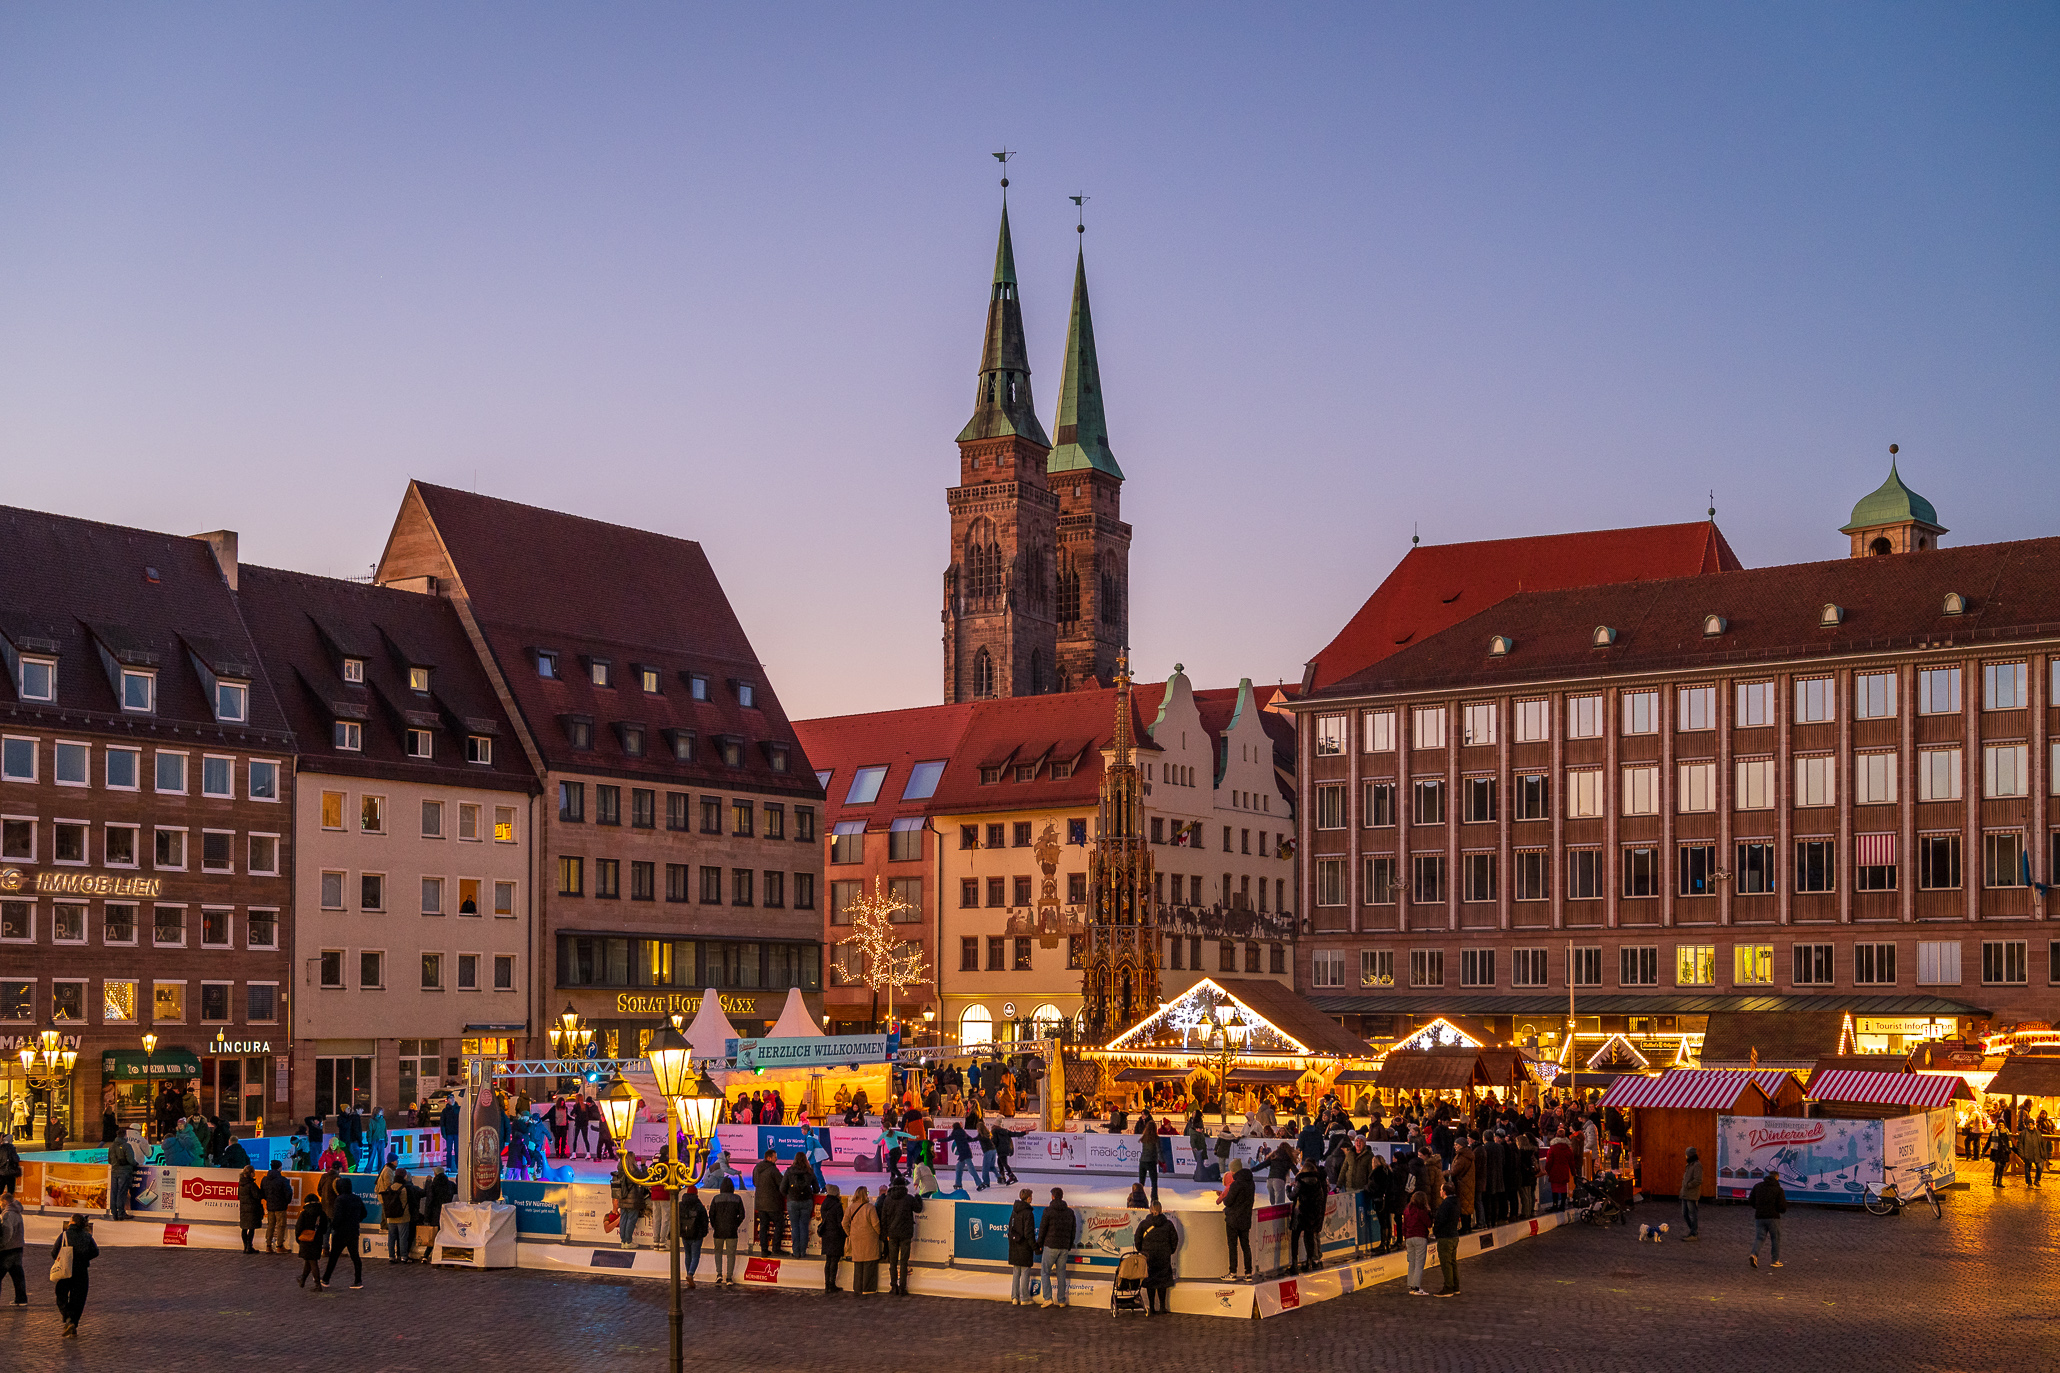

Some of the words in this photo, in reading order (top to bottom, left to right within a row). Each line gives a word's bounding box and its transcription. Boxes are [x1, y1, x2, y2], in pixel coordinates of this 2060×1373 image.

[37, 874, 162, 896] IMMOBILIEN
[617, 993, 666, 1012] SORAT
[668, 994, 703, 1013] HOT
[719, 994, 756, 1013] SAXX
[1875, 1022, 1902, 1030] Tourist
[209, 1041, 271, 1053] LINCURA
[757, 1044, 812, 1059] HERZLICH
[814, 1041, 885, 1058] WILLKOMMEN
[1749, 1122, 1825, 1147] Winterwelt
[514, 1199, 525, 1207] Post
[532, 1200, 556, 1209] Nürnberg
[989, 1223, 1003, 1231] Post
[921, 1237, 940, 1245] Nürnberg
